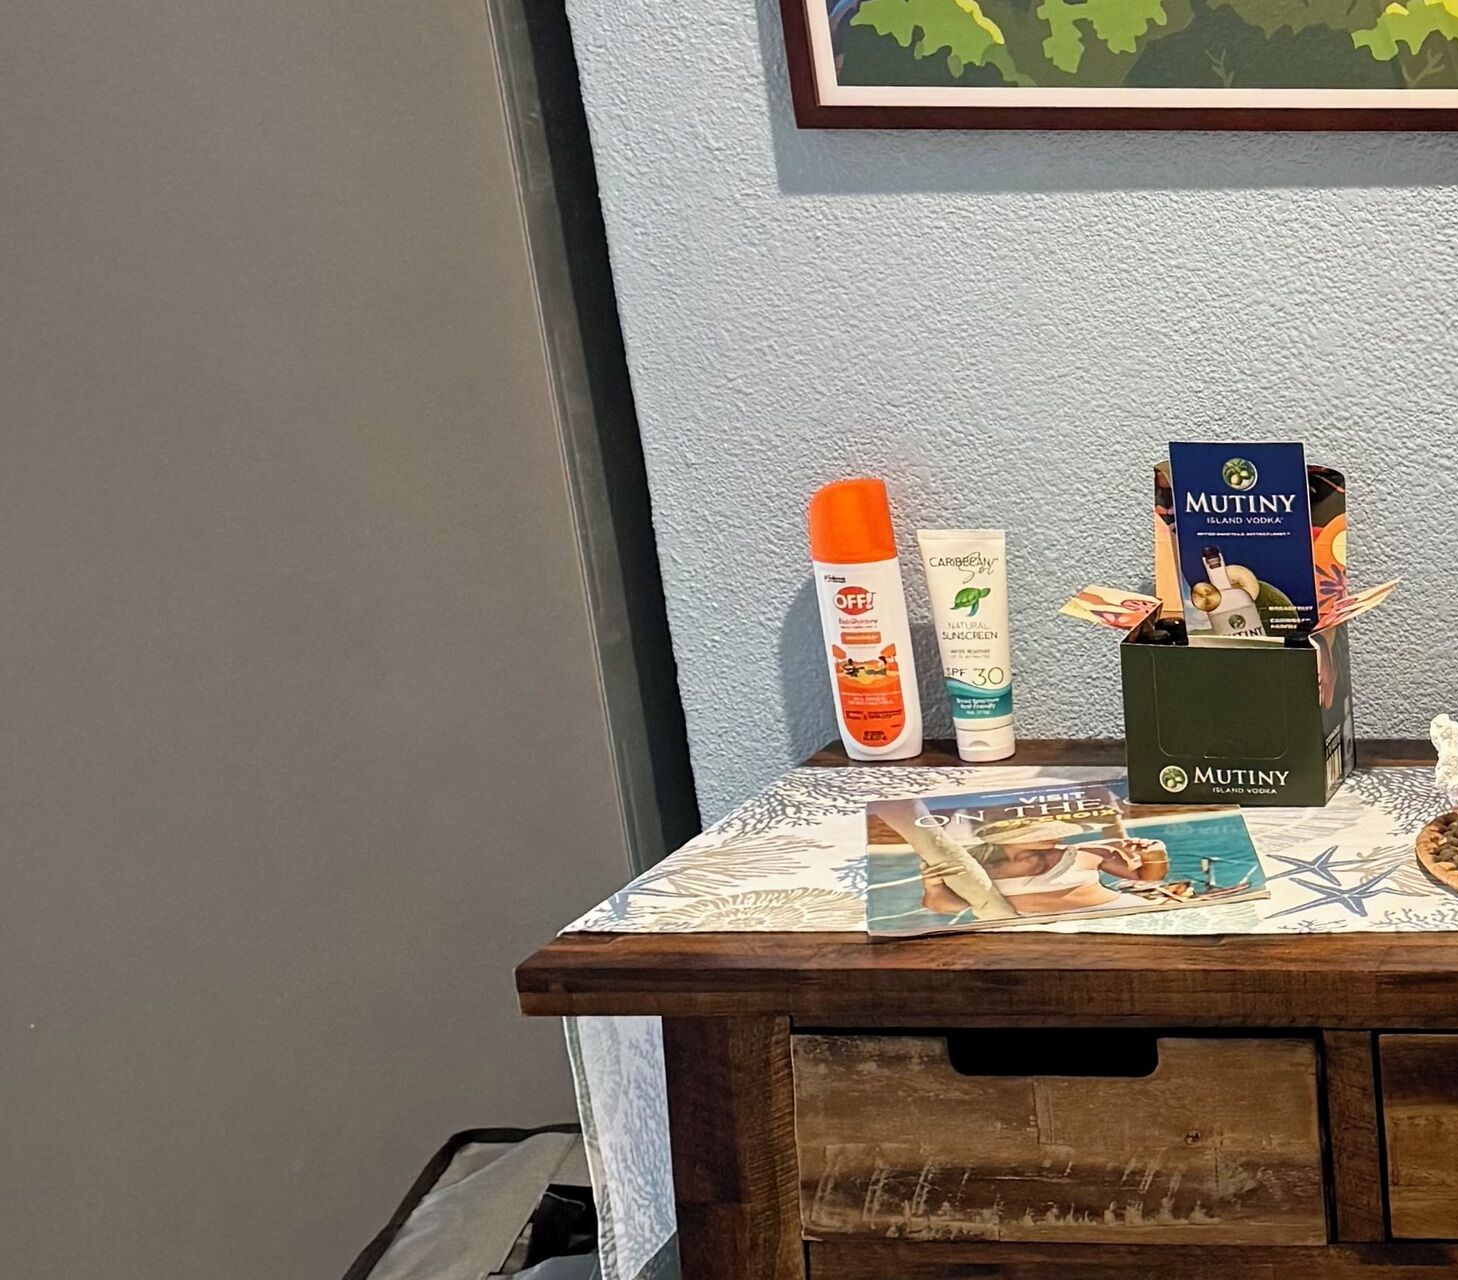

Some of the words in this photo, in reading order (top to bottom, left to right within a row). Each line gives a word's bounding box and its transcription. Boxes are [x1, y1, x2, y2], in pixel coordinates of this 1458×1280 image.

[1185, 491, 1297, 513] MUTINY
[834, 591, 874, 610] OFF!
[942, 631, 998, 640] SUNSCREEN
[946, 666, 968, 677] SPF
[972, 666, 1005, 686] 30
[1194, 766, 1289, 786] MUTINY
[1018, 791, 1086, 804] VISIT
[914, 810, 985, 828] ON
[1004, 798, 1105, 819] THE
